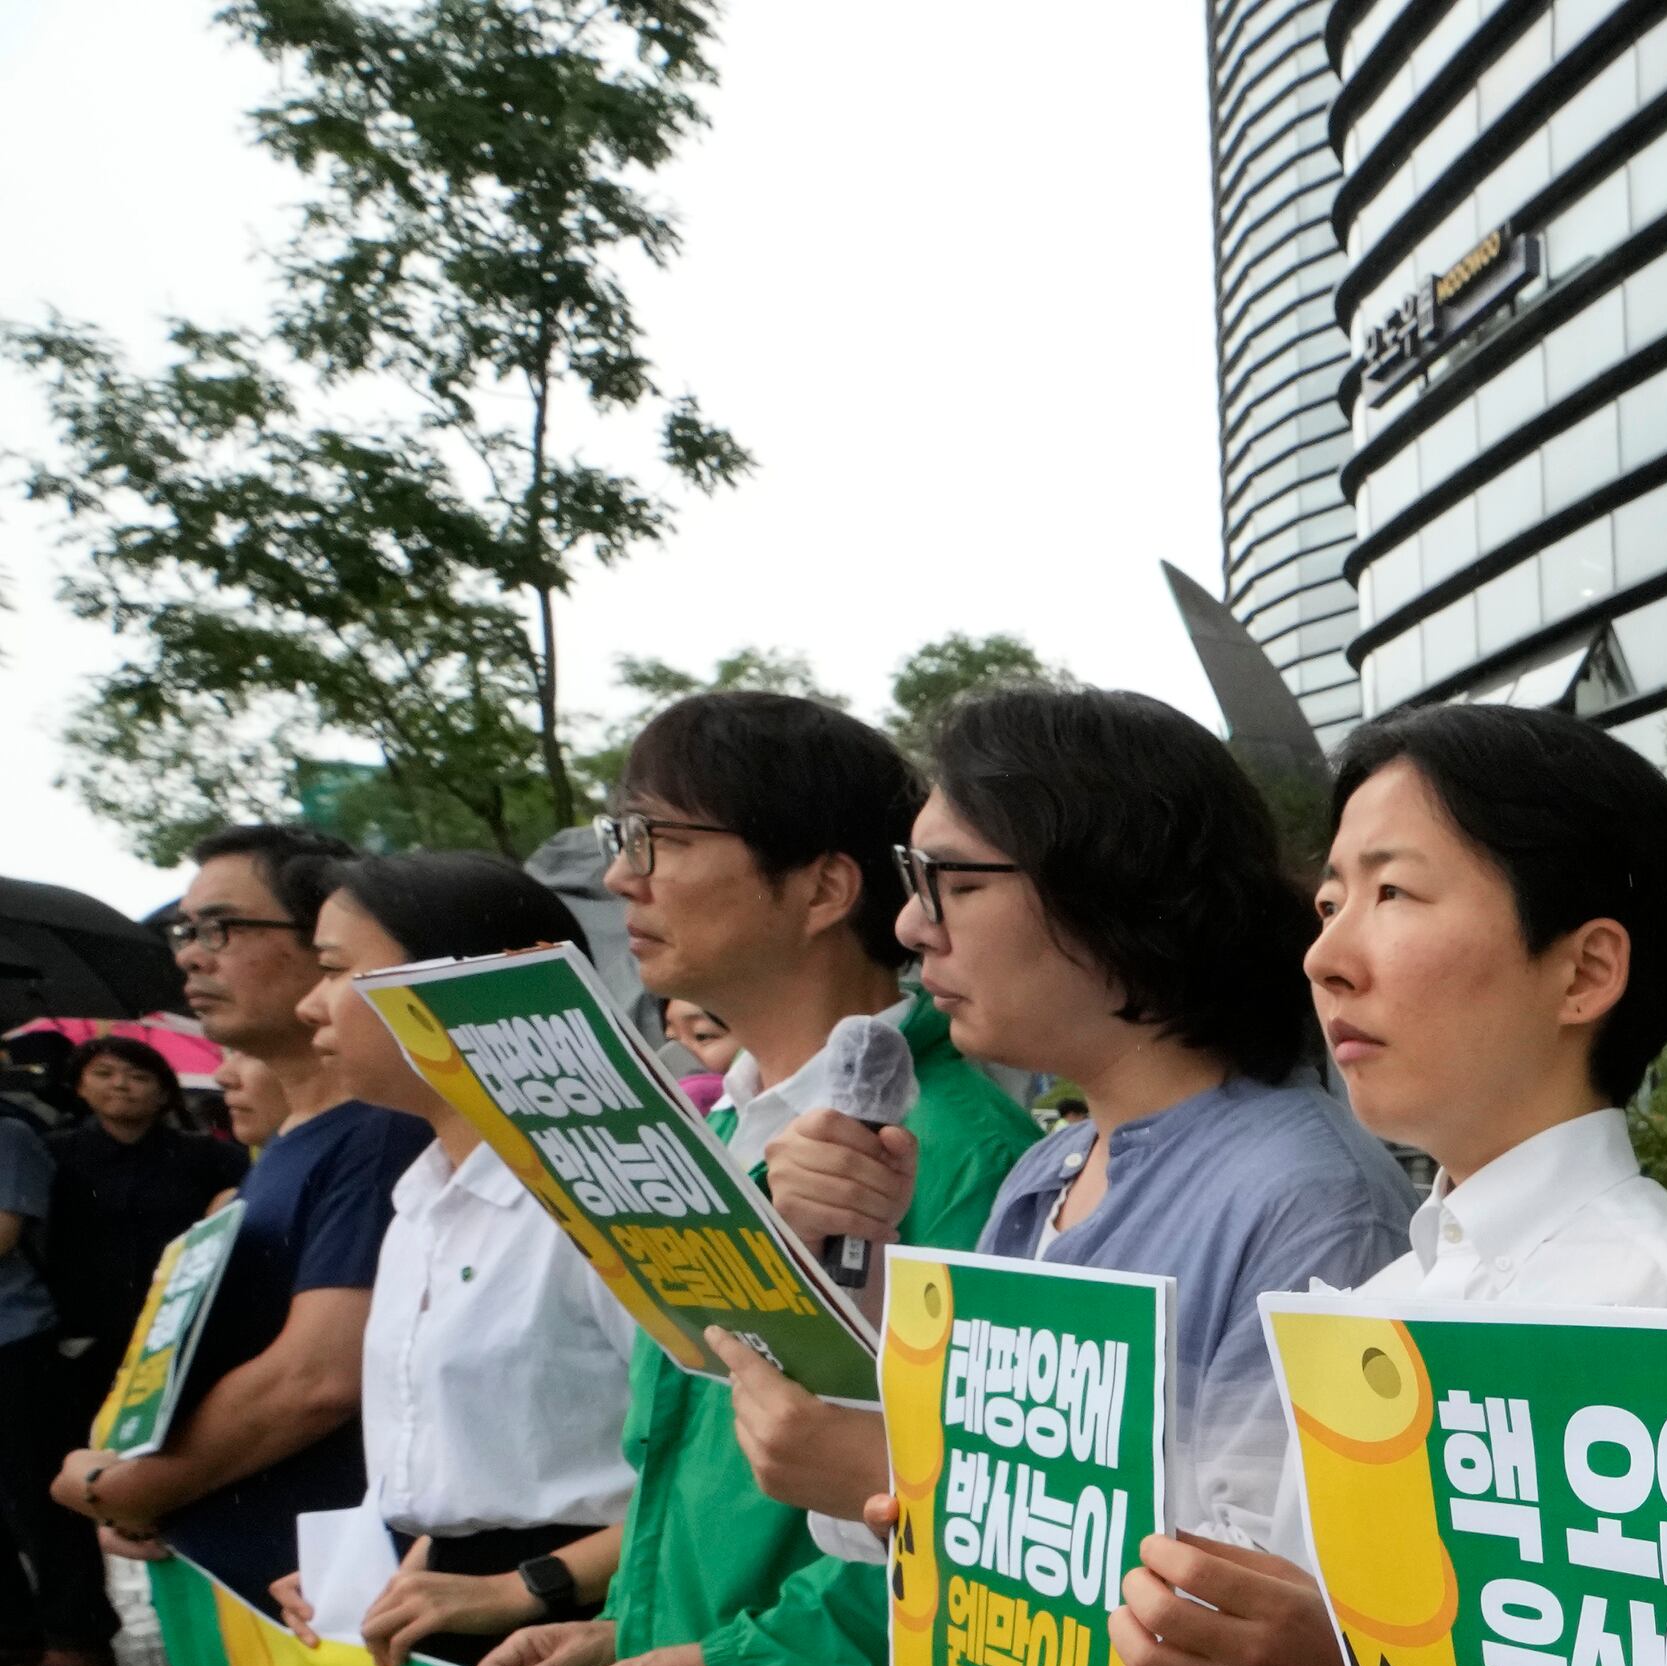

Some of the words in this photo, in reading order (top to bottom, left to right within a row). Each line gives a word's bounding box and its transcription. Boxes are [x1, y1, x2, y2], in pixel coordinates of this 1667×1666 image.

[447, 1007, 645, 1118] 태평양에
[529, 1120, 731, 1218] 방사능이
[610, 1225, 819, 1316] 웬말이냐!
[944, 1317, 1130, 1469] 태평양에
[943, 1447, 1129, 1615] 방사능이
[1437, 1389, 1545, 1564] 핵
